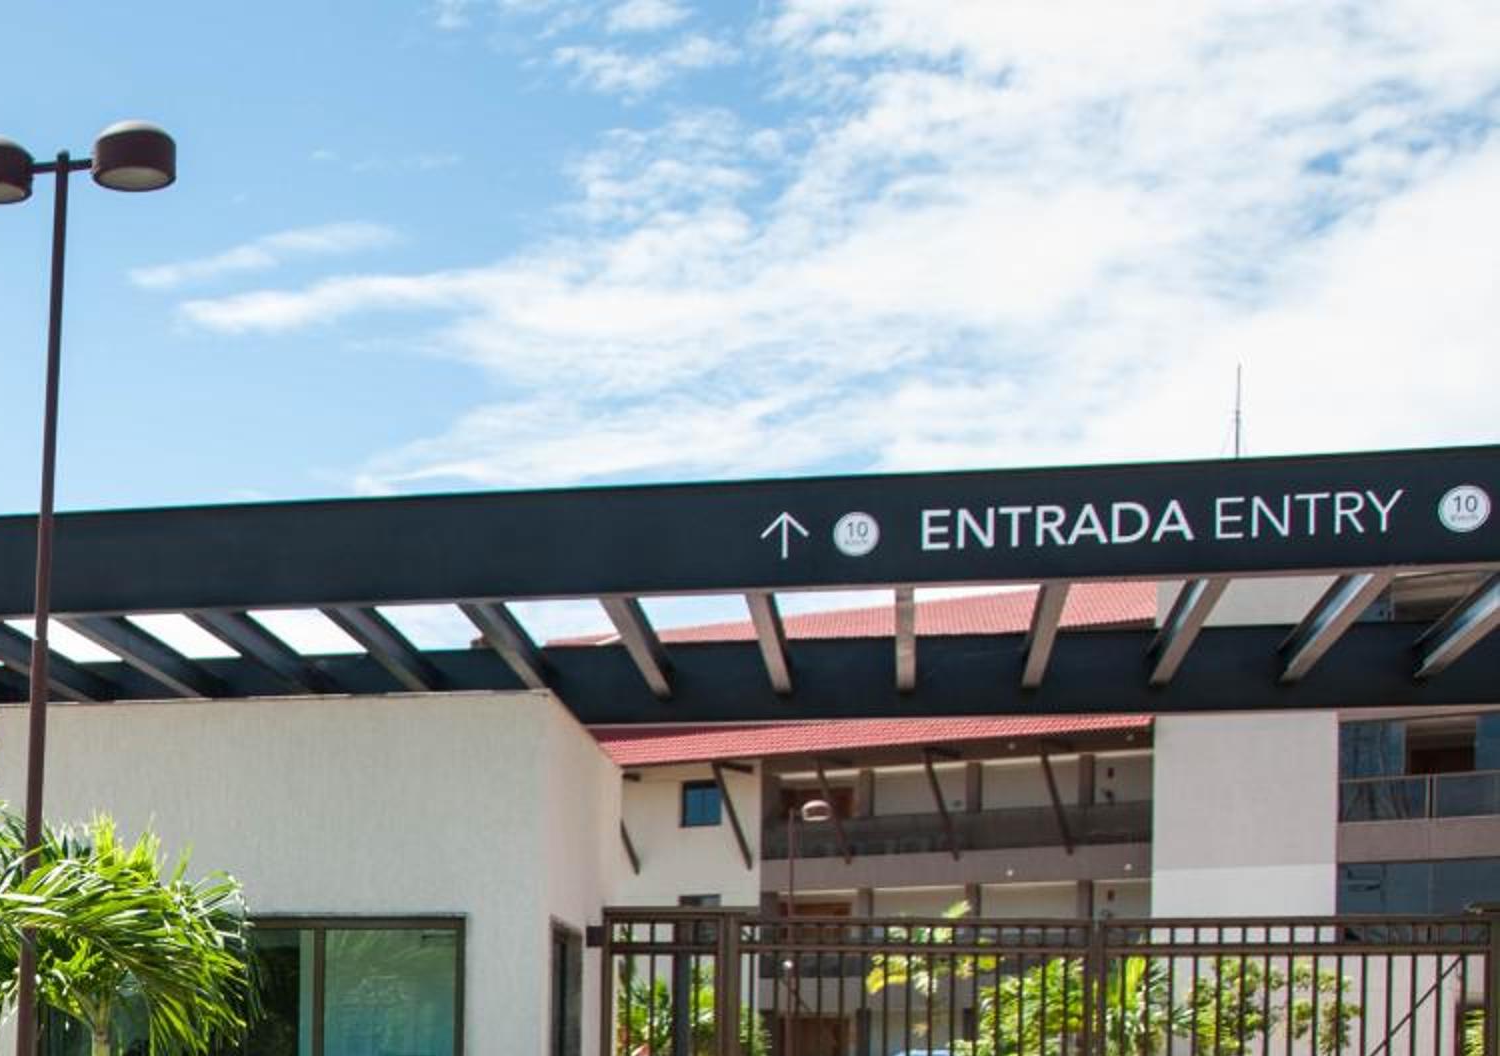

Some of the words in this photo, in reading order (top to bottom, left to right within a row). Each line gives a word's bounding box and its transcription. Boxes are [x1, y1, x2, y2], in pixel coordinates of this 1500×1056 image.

[1454, 495, 1477, 513] 10
[920, 499, 1195, 551] ENTRADA
[1214, 488, 1404, 539] ENTRY
[846, 521, 869, 538] 10
